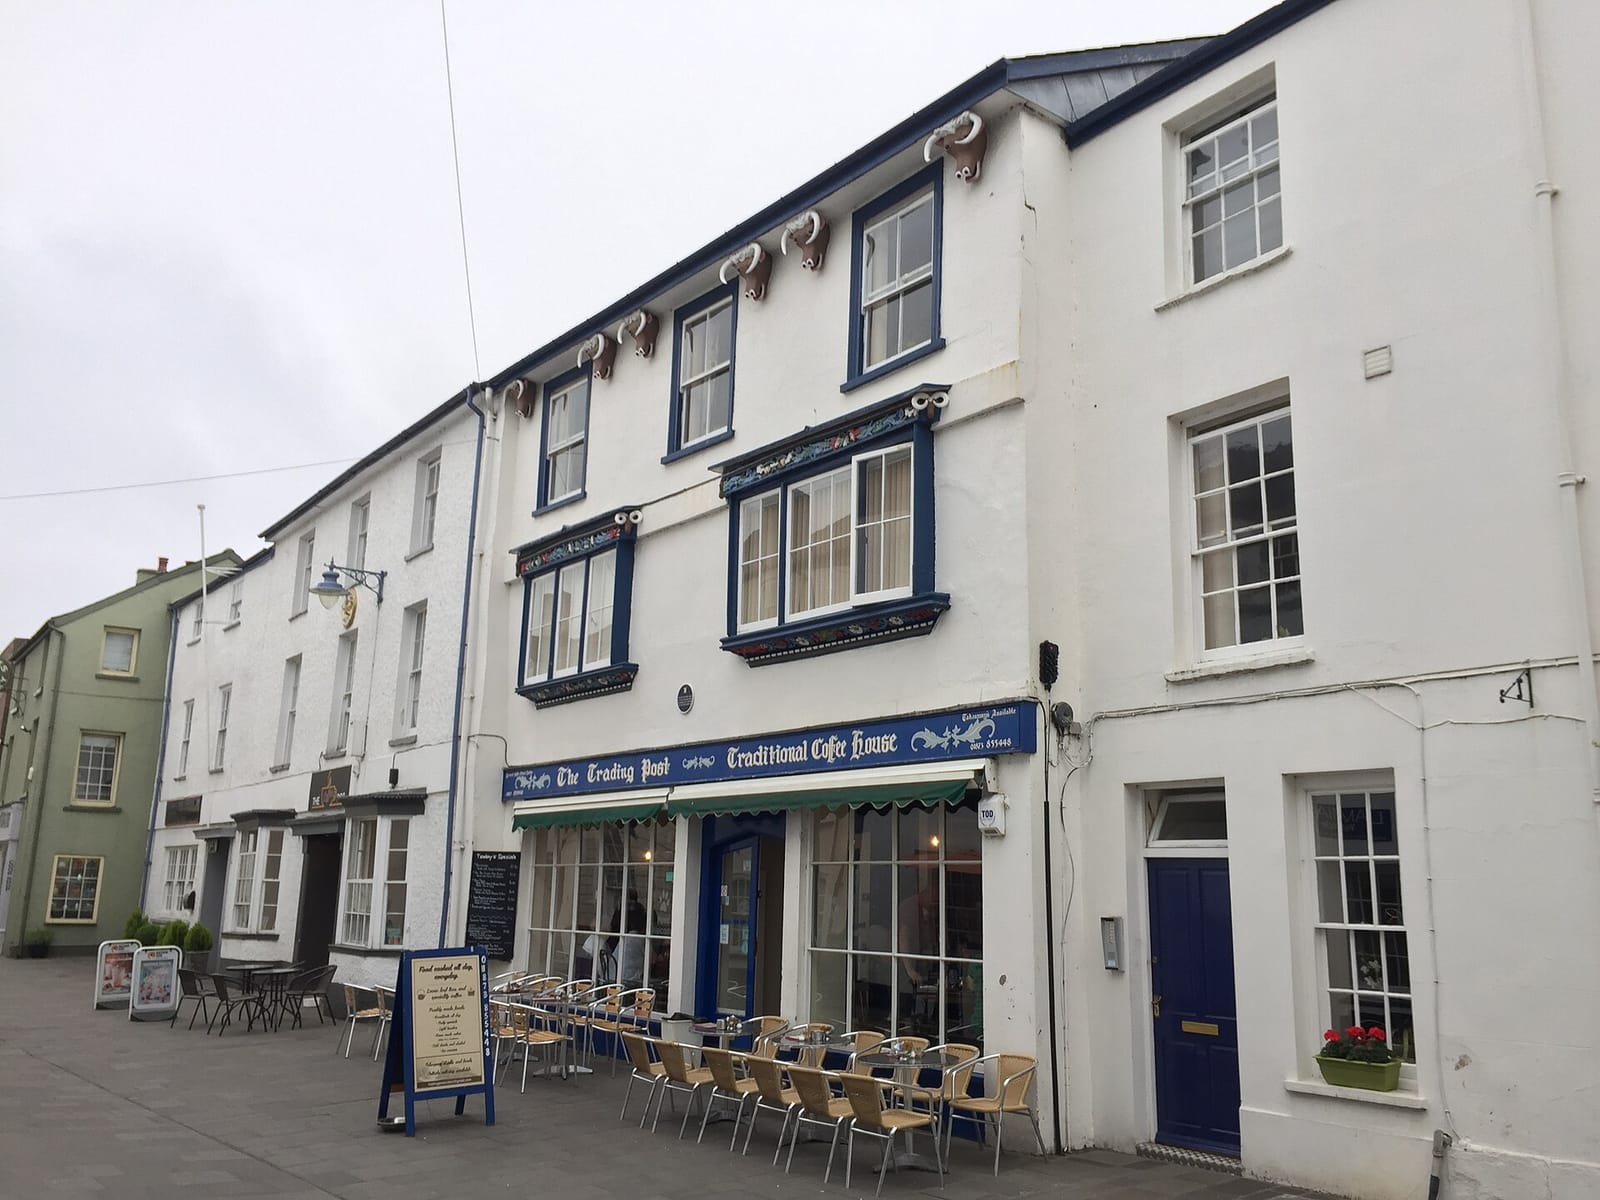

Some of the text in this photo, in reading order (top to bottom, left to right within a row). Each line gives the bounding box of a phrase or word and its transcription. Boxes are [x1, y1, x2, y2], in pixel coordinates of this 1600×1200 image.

[727, 729, 898, 769] Traditional Coffee House
[557, 756, 671, 787] The Trading Post
[981, 810, 994, 818] TOD
